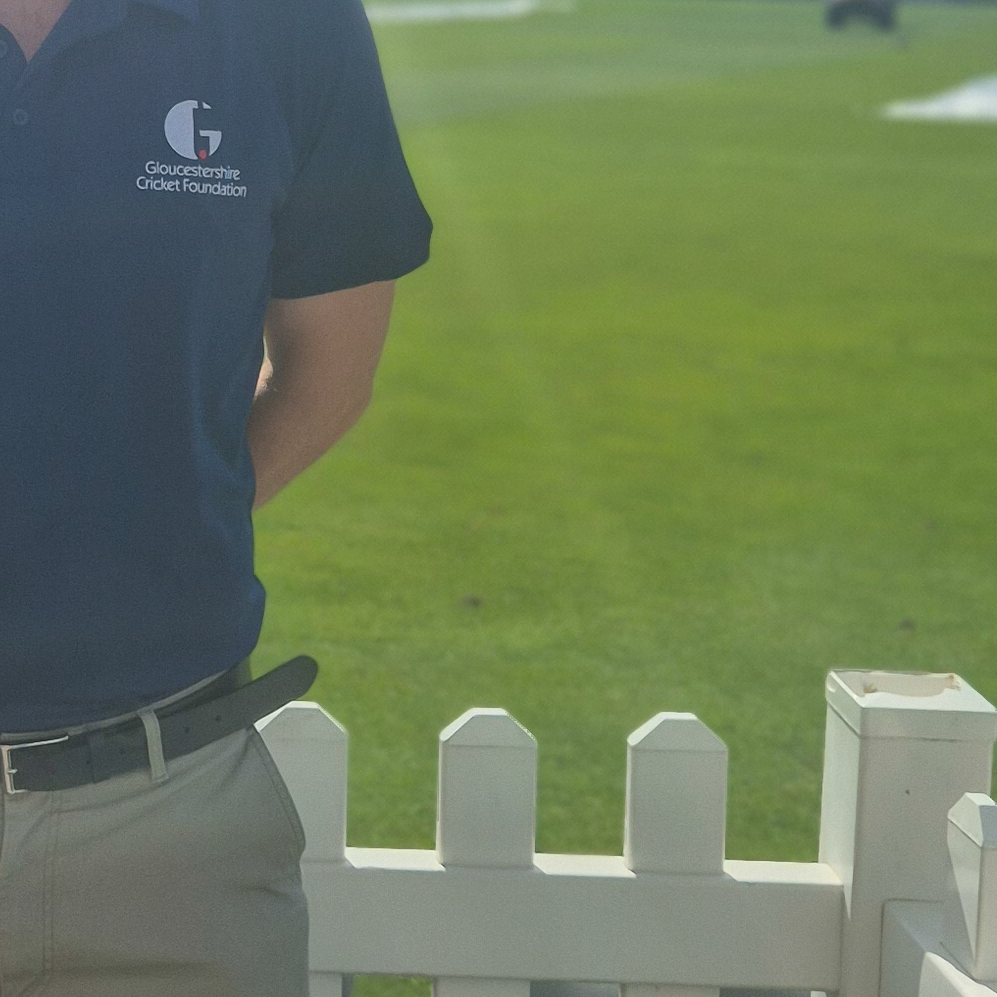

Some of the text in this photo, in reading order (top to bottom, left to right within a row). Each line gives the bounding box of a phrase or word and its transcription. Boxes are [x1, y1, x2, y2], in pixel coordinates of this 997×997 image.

[145, 161, 241, 180] Gloucestershire
[136, 176, 248, 197] Cricket Foundation
